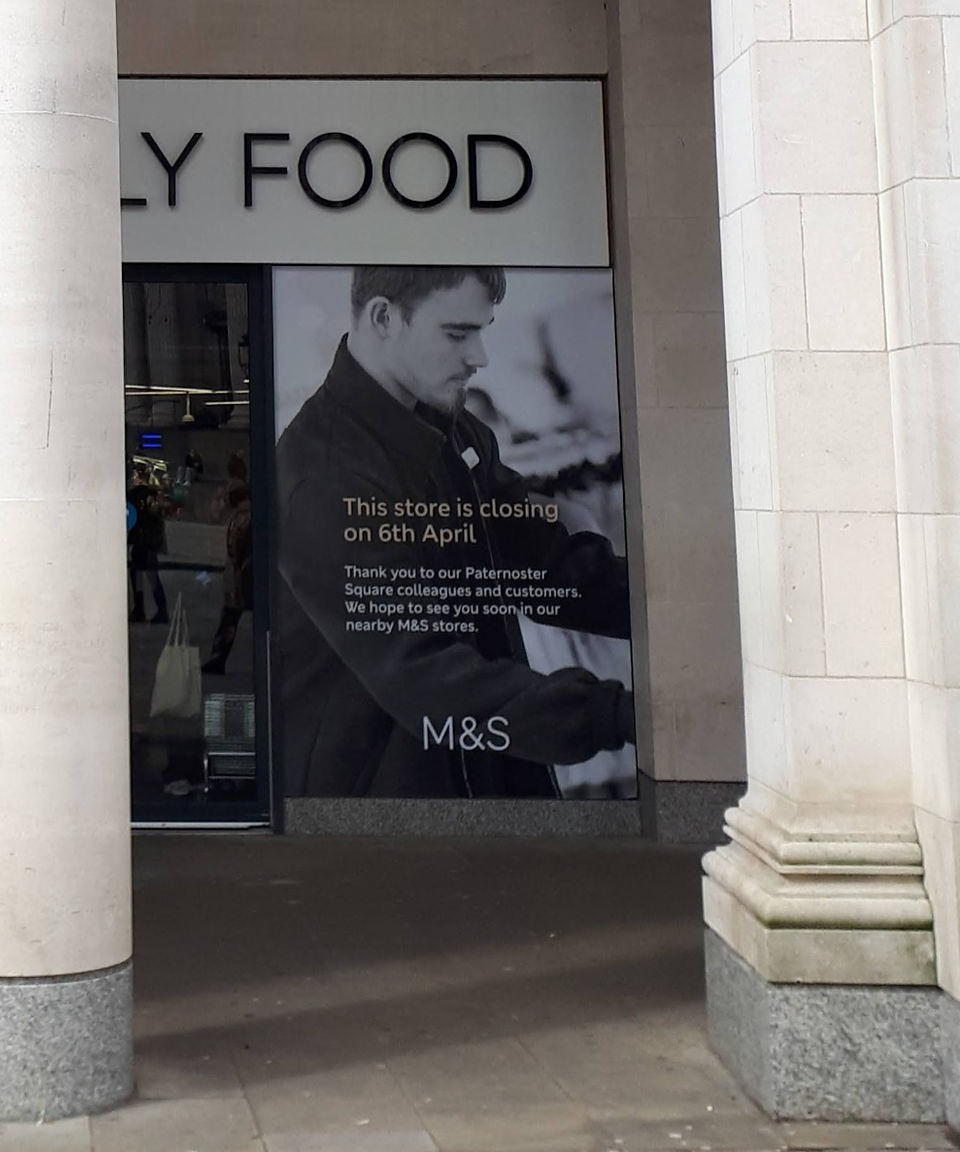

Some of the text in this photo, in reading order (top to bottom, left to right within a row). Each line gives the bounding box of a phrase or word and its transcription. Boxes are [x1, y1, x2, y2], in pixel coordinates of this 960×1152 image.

[243, 131, 534, 210] FOOD
[343, 497, 559, 522] This store is closing
[344, 524, 477, 547] on 6th April
[344, 566, 547, 582] Thank you to our Paternoster
[344, 584, 582, 600] Square colleagues and customers.
[345, 602, 560, 618] We hope to see you soon in our
[345, 619, 479, 634] nearby M&S stores.
[423, 715, 510, 751] M&S
